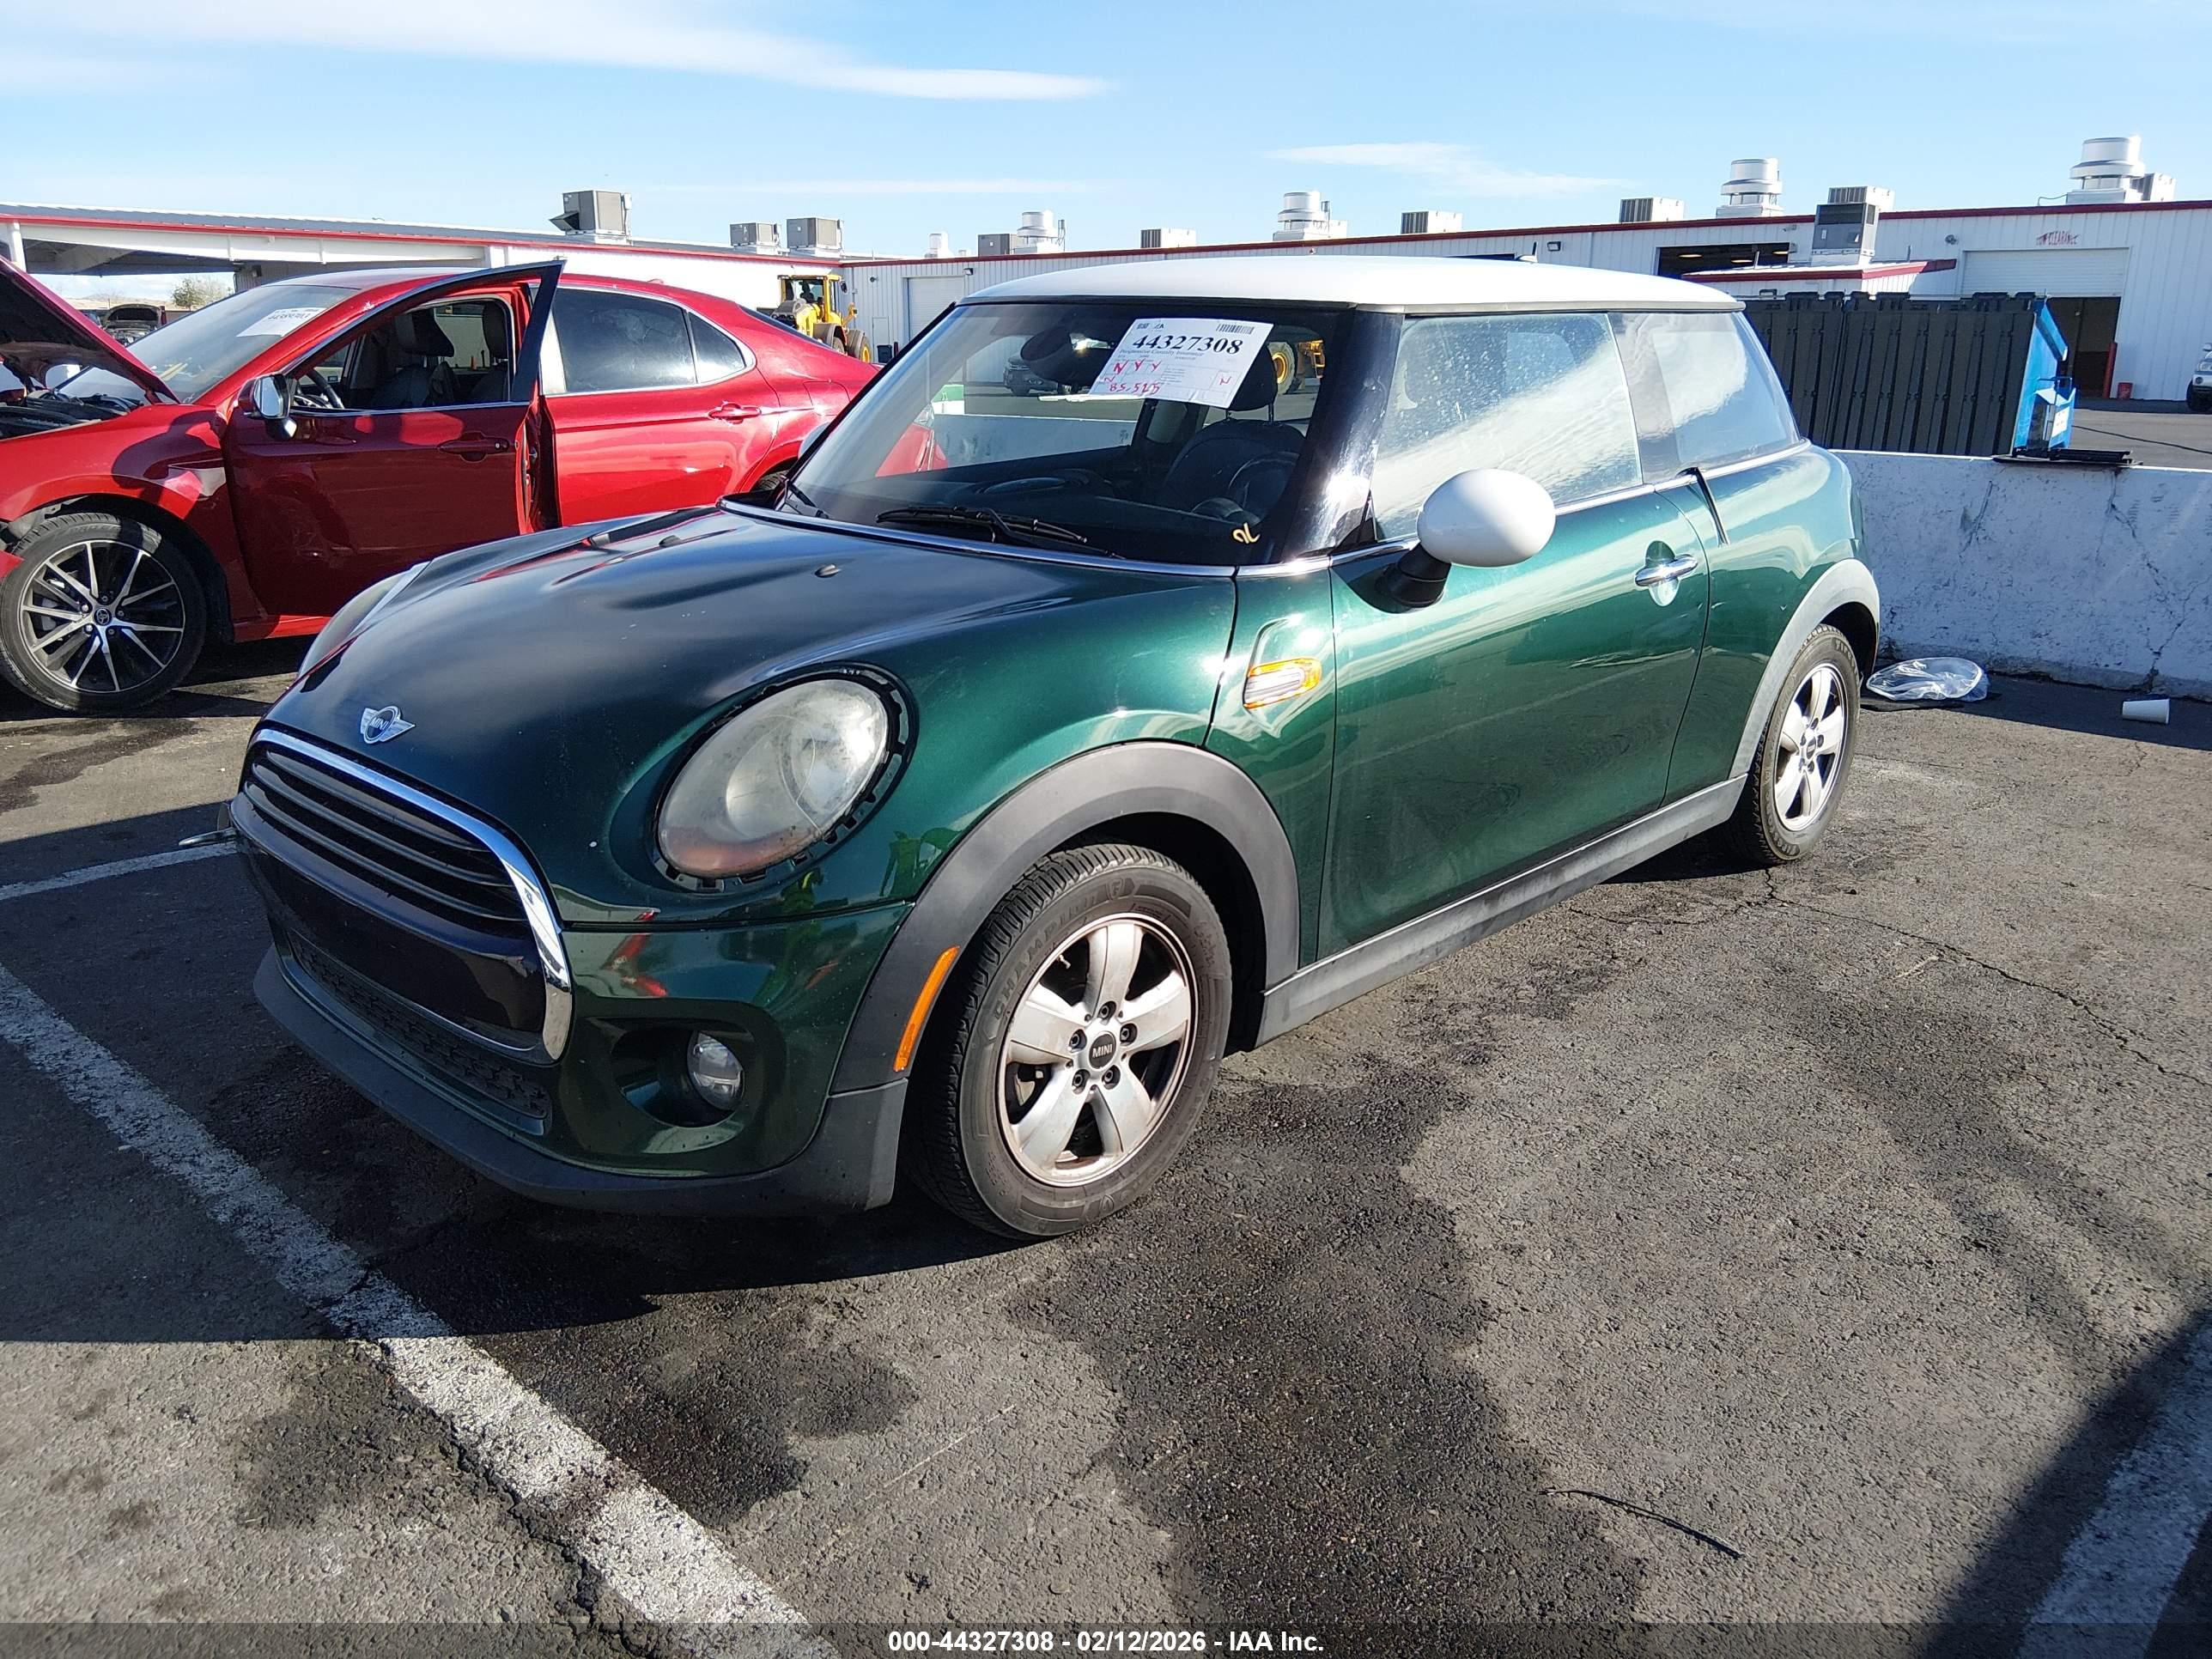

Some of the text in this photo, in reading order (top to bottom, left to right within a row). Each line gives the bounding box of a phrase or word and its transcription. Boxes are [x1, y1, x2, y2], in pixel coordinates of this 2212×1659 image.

[1133, 335, 1243, 355] 44327308
[369, 717, 390, 731] MINI
[1091, 1043, 1113, 1059] MINI
